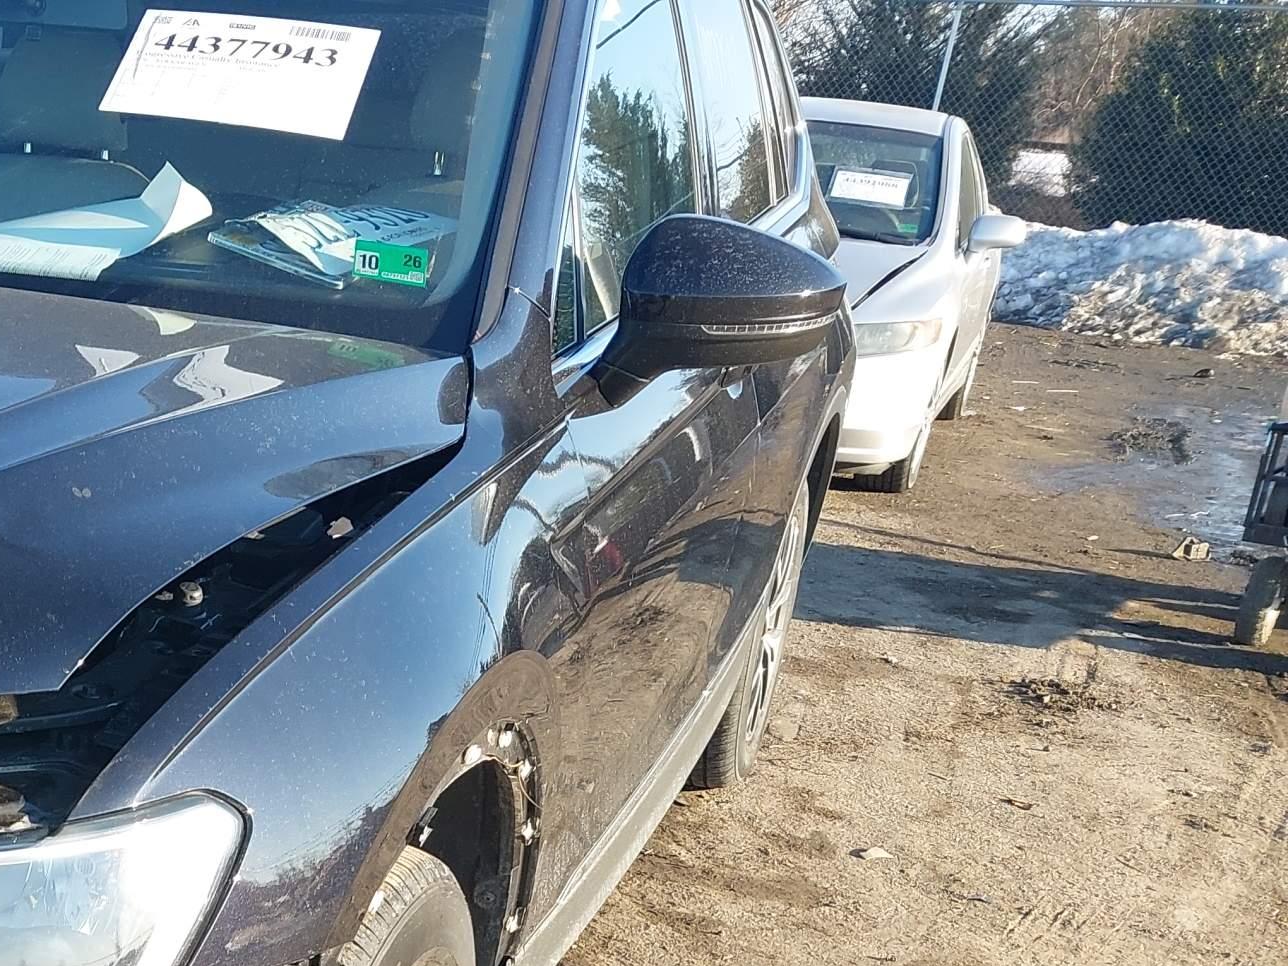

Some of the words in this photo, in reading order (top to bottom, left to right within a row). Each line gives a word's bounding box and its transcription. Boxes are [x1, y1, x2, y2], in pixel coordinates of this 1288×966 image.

[154, 33, 339, 67] 44377943
[359, 253, 379, 271] 10
[403, 253, 422, 269] 26
